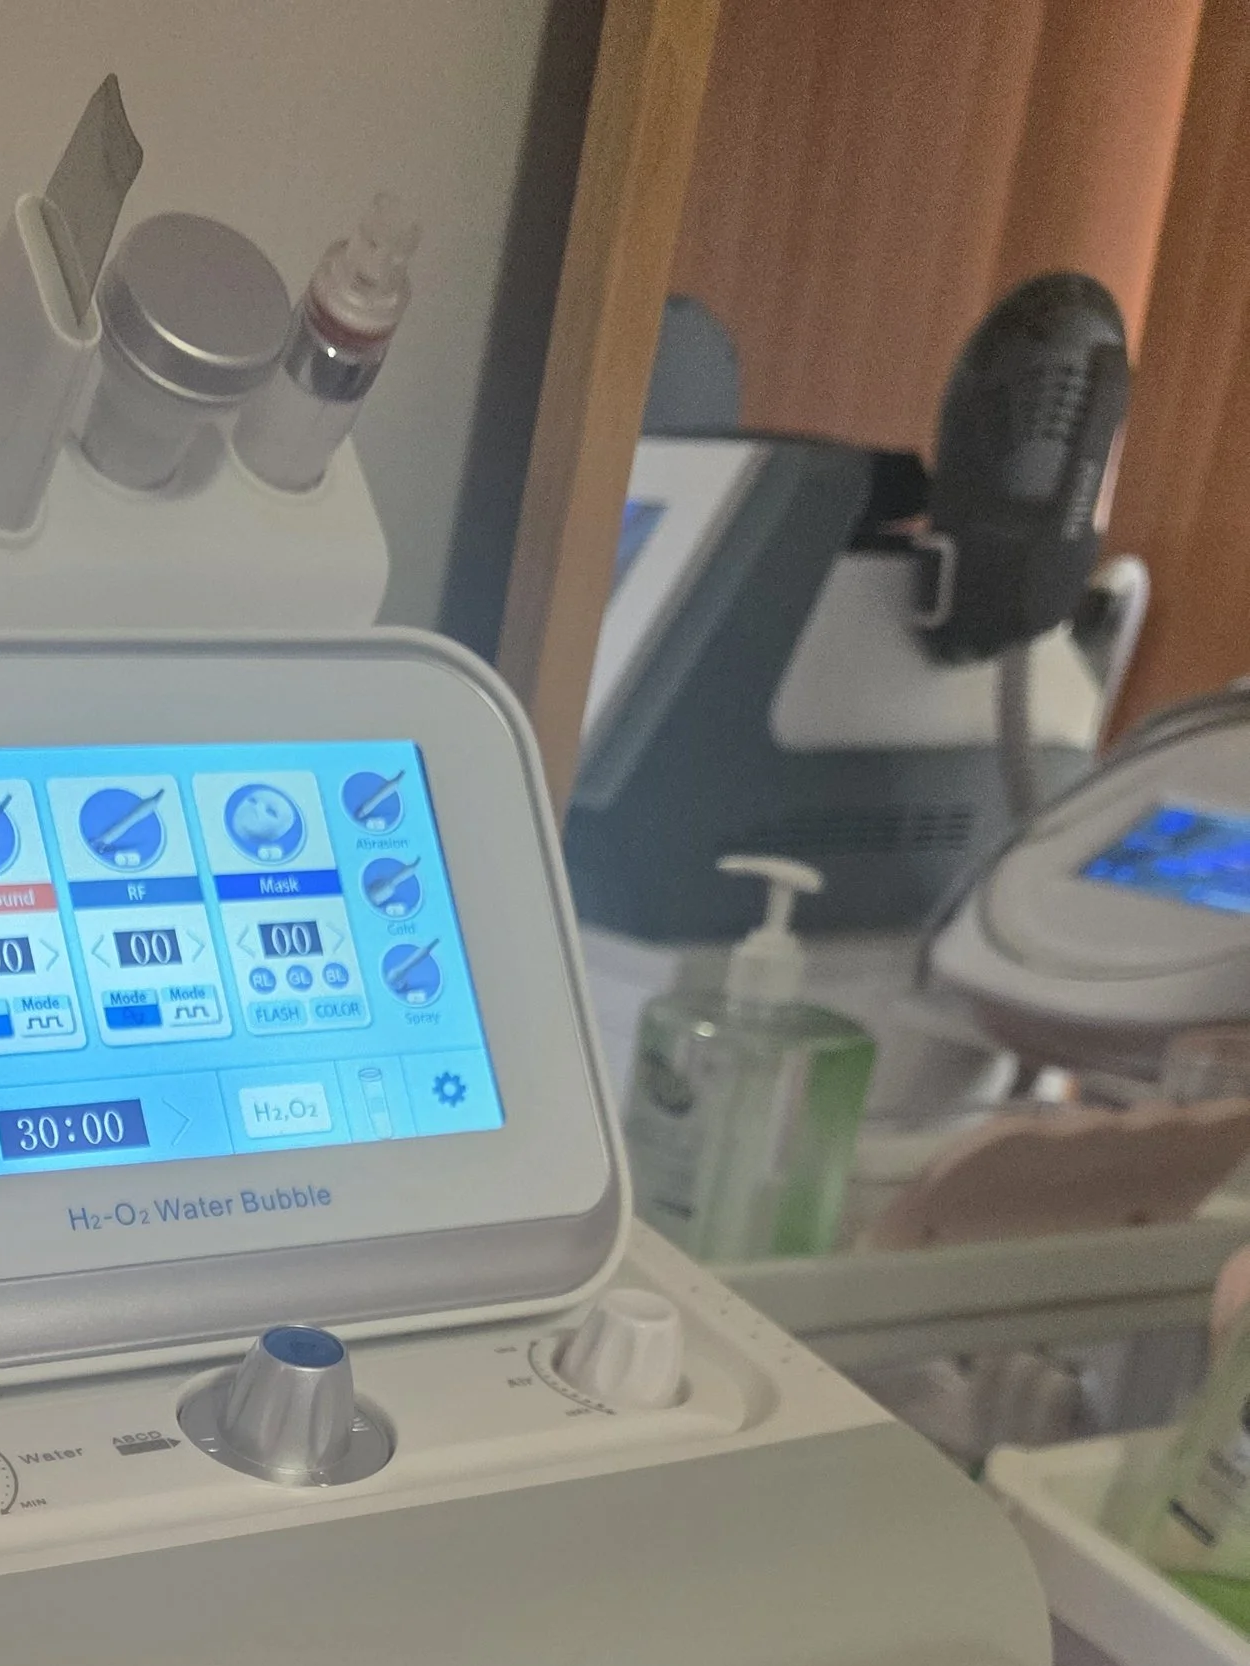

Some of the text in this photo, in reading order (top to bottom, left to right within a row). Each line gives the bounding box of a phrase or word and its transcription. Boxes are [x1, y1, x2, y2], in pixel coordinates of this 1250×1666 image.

[356, 838, 410, 851] Abrasion
[127, 884, 147, 901] RF
[259, 878, 299, 895] Mask
[130, 931, 172, 966] 00
[271, 923, 312, 957] 00
[252, 973, 274, 988] RL
[110, 991, 146, 1006] Mode
[170, 985, 206, 1001] Mode
[21, 996, 60, 1012] Mode
[315, 1001, 362, 1018] COLOR
[255, 1005, 300, 1023] FLASH
[17, 1110, 125, 1151] 30:00
[154, 1191, 234, 1223] Water
[240, 1183, 332, 1213] Bubble
[112, 1430, 162, 1445] ABCD
[18, 1447, 84, 1466] Water
[20, 1497, 47, 1510] MIN
